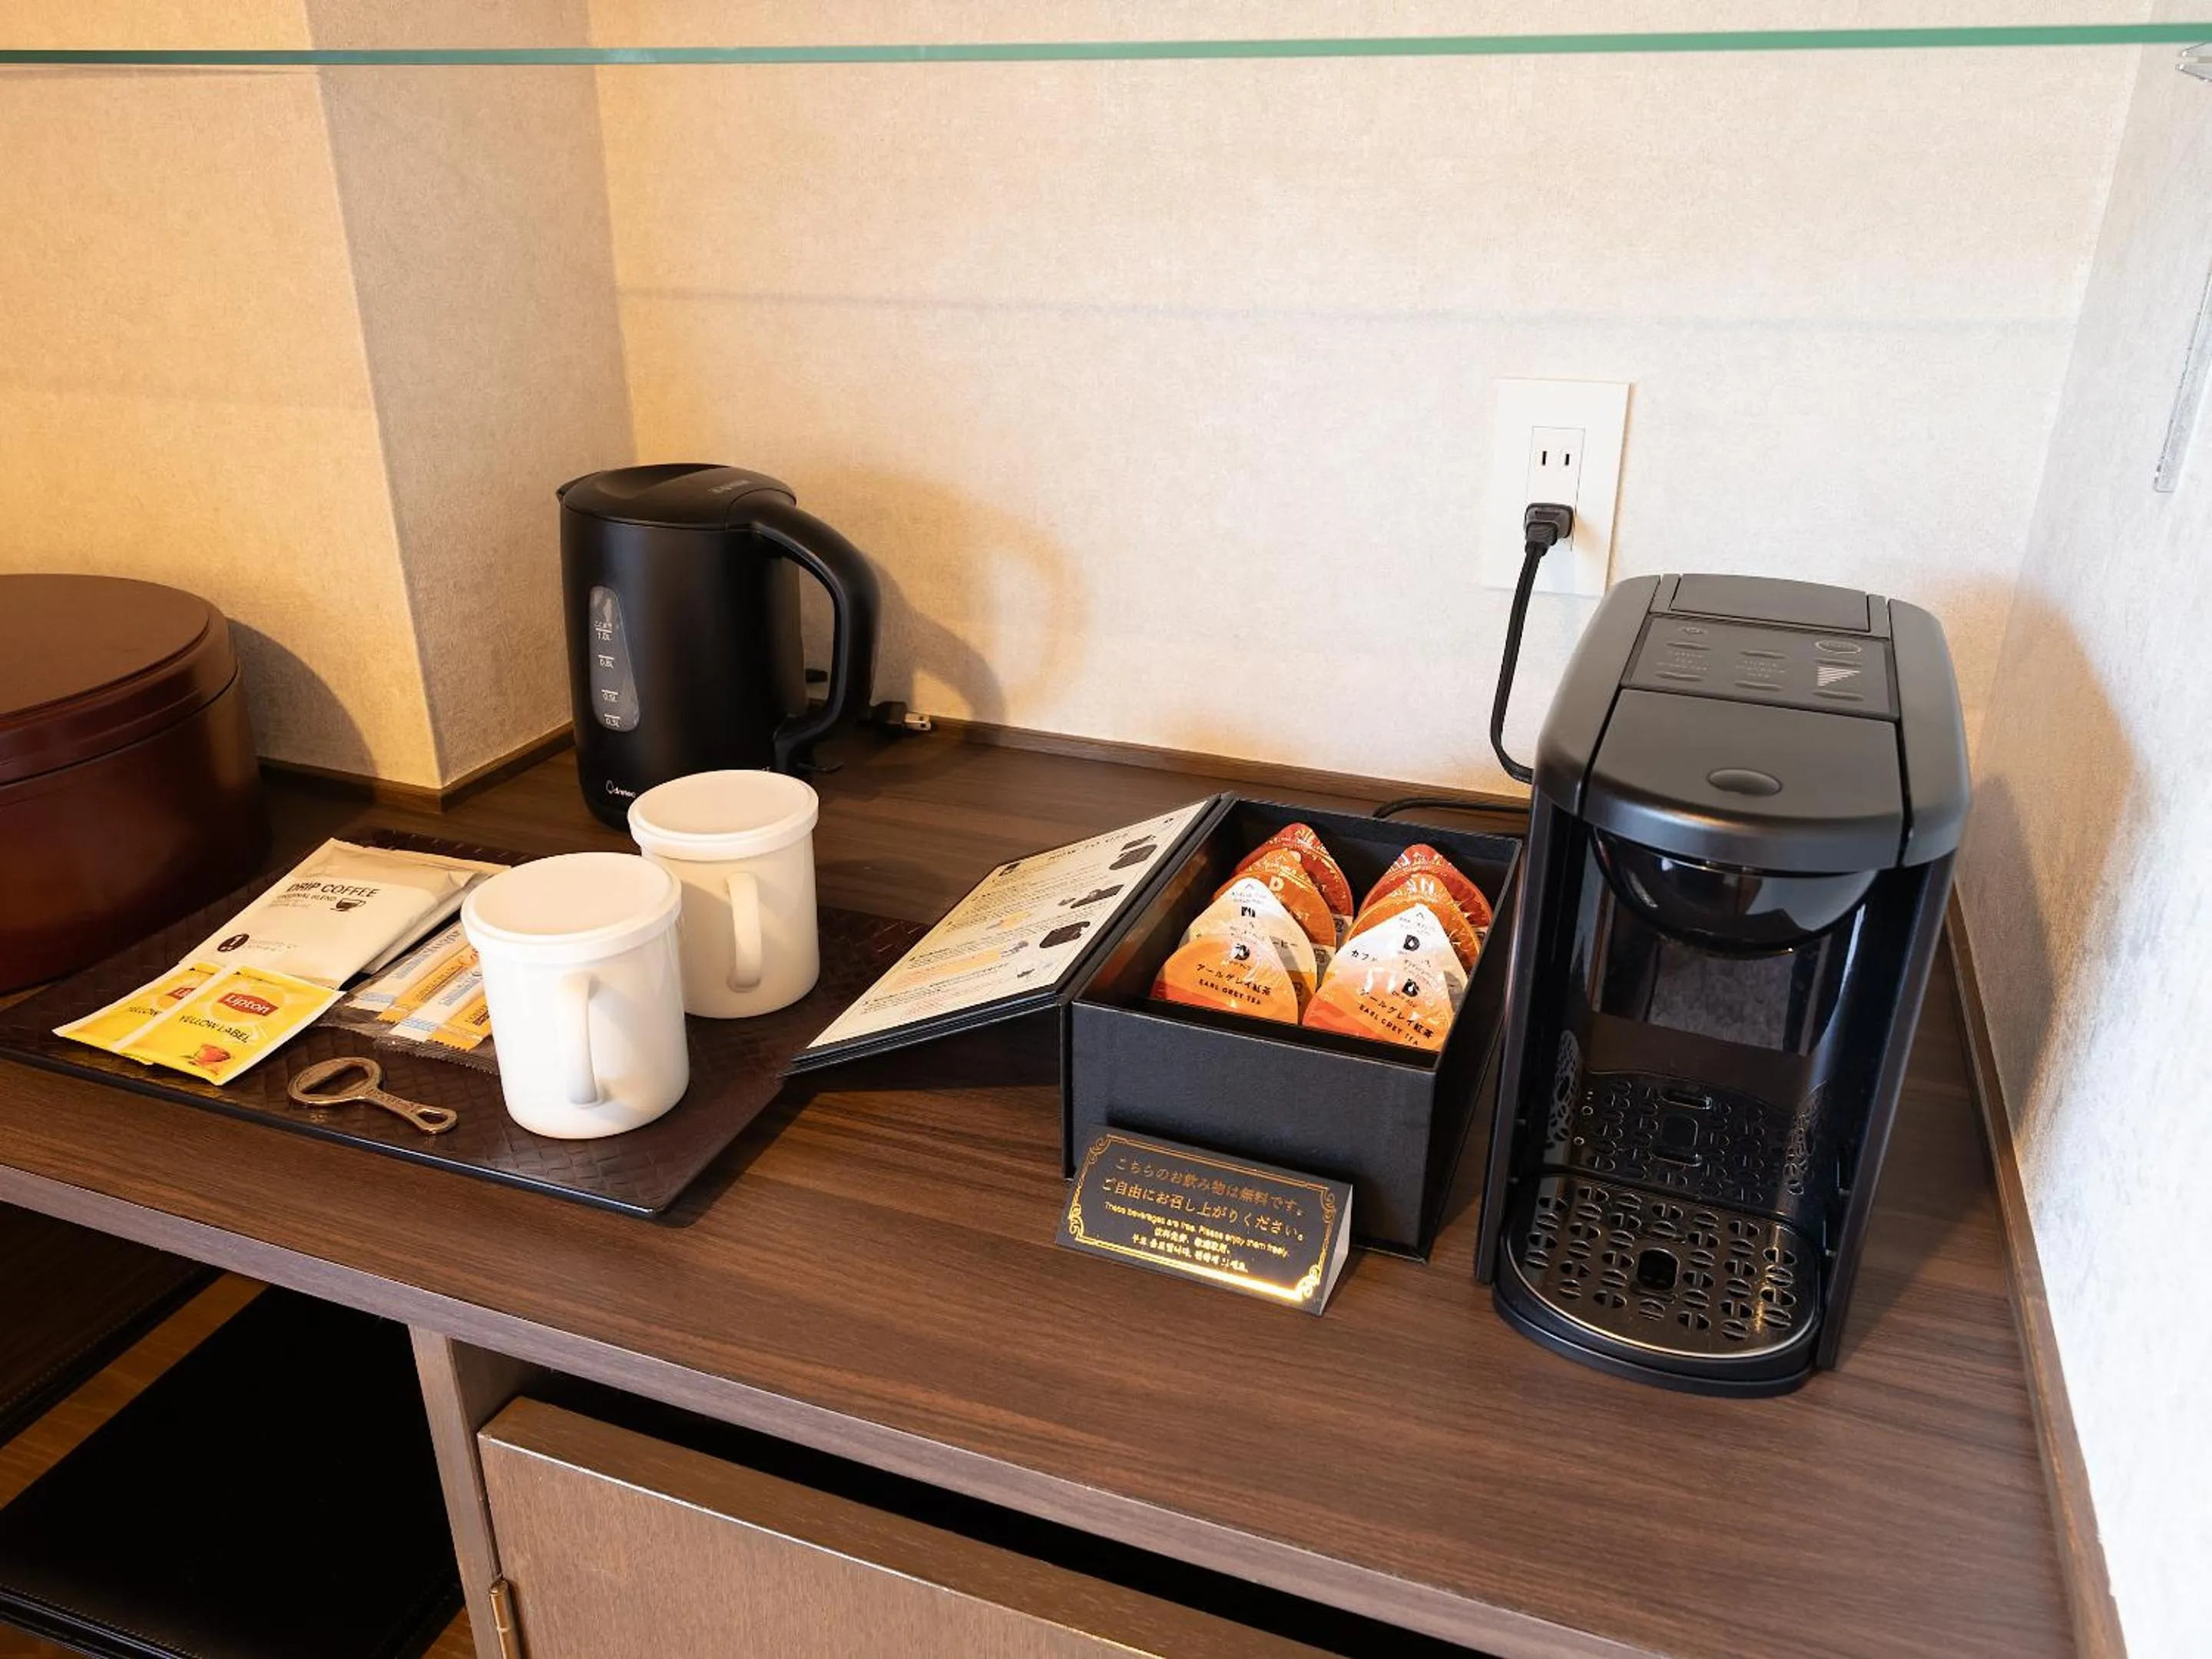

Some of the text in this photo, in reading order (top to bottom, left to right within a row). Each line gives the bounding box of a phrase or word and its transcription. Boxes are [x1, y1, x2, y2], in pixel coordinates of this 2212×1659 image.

[286, 881, 381, 898] DRIP COFFEE
[224, 994, 270, 1015] Lipton
[1199, 979, 1261, 1005] EARL GREY TEA
[179, 1014, 250, 1044] YELLOW LABEL
[1358, 1004, 1379, 1021] EARL
[1381, 1018, 1402, 1035] GREY
[1114, 1157, 1303, 1217] こちらのお飲み物は無料です。
[1101, 1176, 1305, 1243] ご自由にお召し上がりください。
[1225, 1233, 1245, 1247] enjoy
[1247, 1238, 1266, 1250] them
